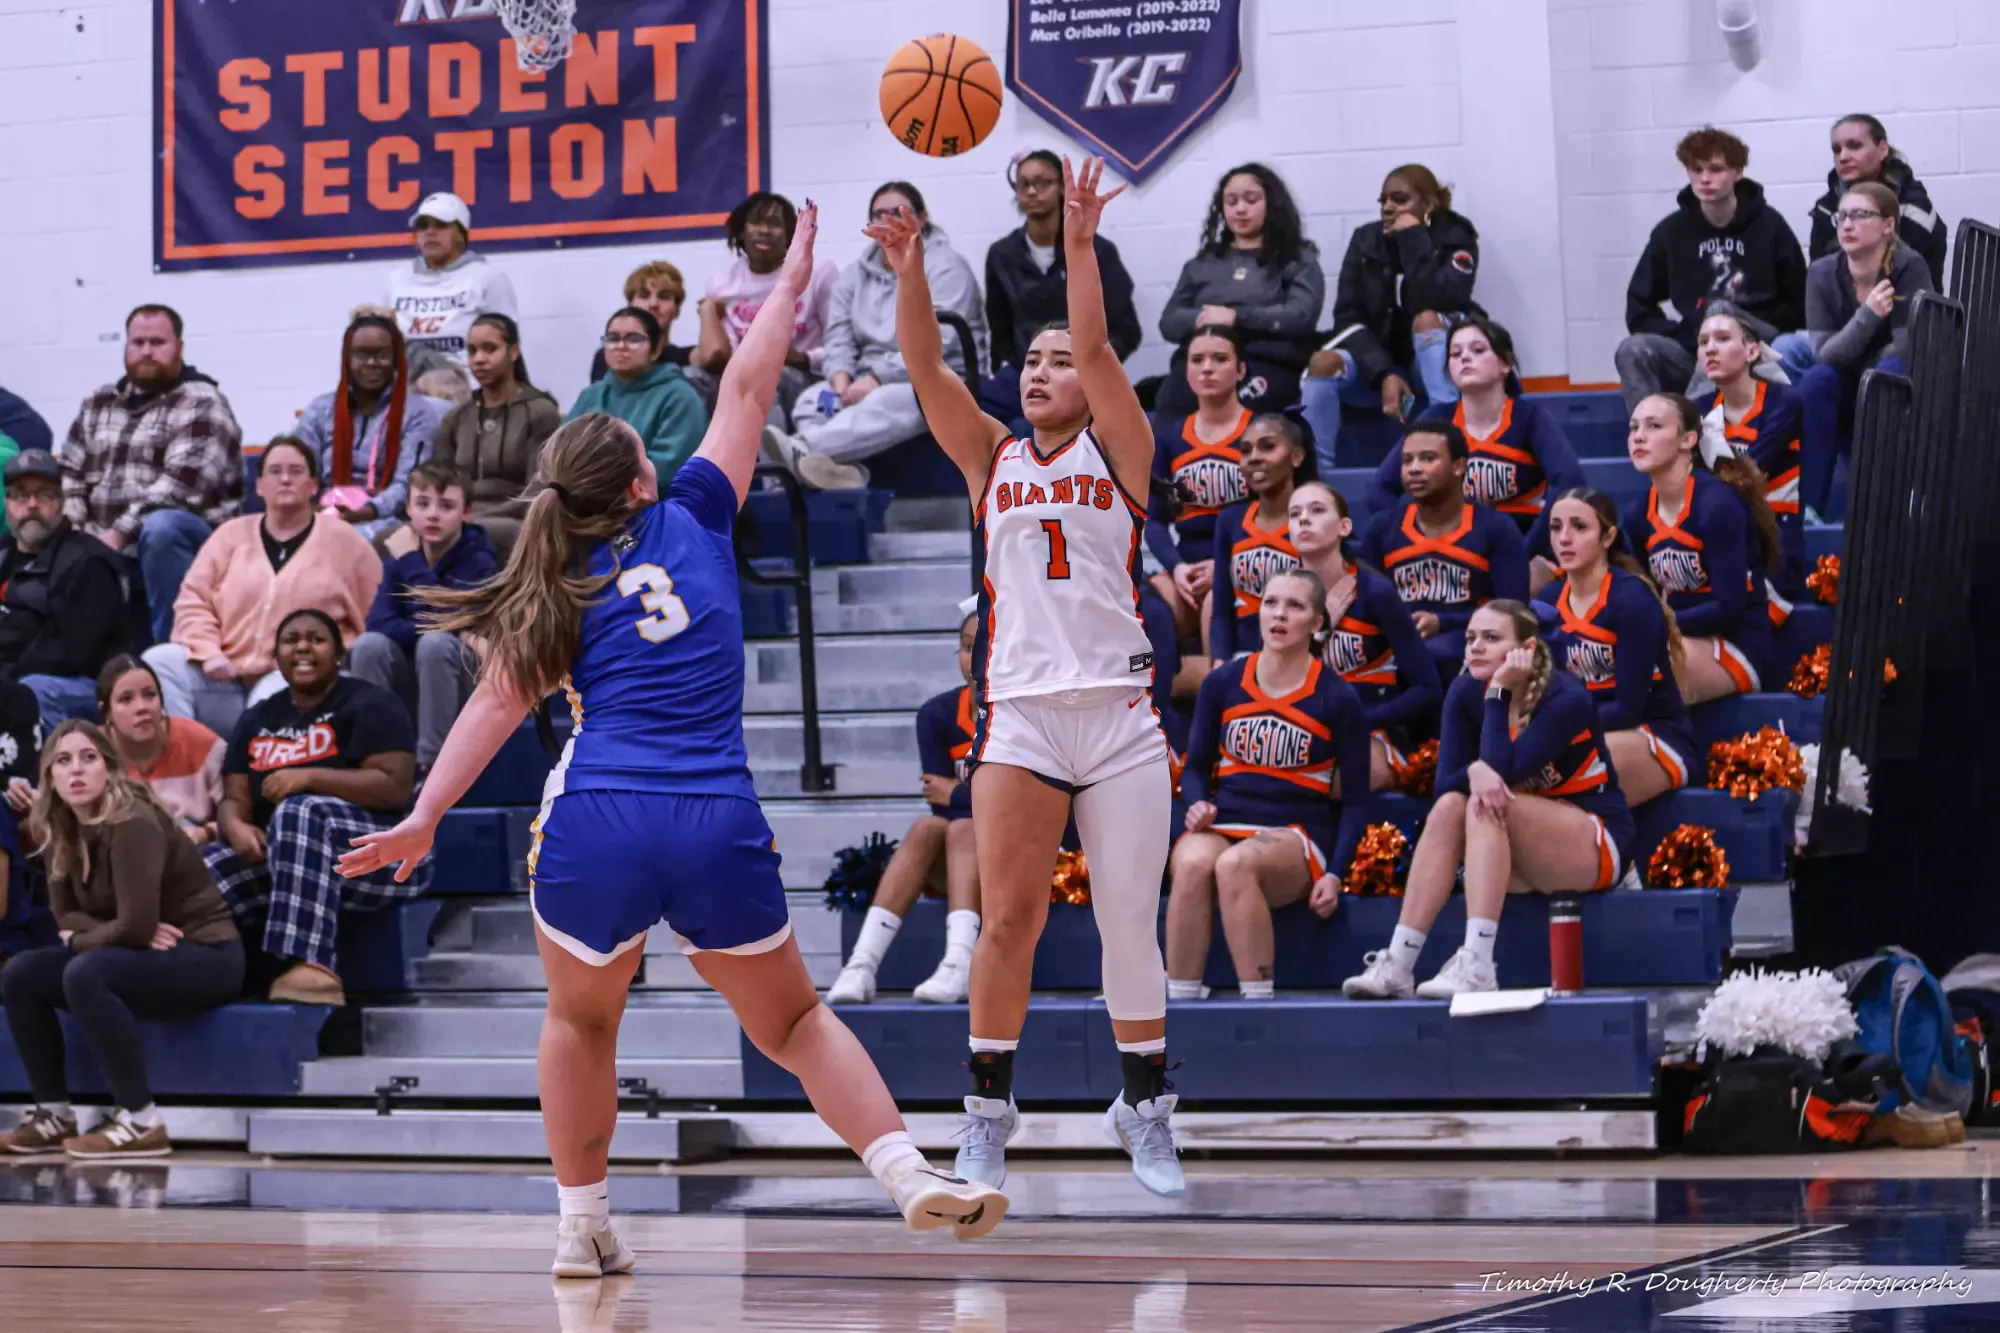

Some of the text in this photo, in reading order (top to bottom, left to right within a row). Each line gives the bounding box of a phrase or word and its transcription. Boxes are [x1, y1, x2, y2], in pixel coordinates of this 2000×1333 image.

[1030, 10, 1066, 24] Bella
[1136, 0, 1221, 19] (2019-2022)
[1030, 28, 1061, 42] Mac
[1127, 16, 1212, 38] (2019-2022)
[218, 23, 697, 132] STUDENT
[1078, 51, 1190, 110] KC
[232, 116, 678, 219] SECTION
[996, 474, 1114, 513] GIANTS
[1176, 462, 1249, 505] EYSTONE
[1464, 457, 1518, 503] STONE
[1039, 519, 1071, 580] 1
[616, 562, 690, 644] 3
[252, 723, 332, 766] TIRED
[1226, 716, 1312, 768] KEYSTONE
